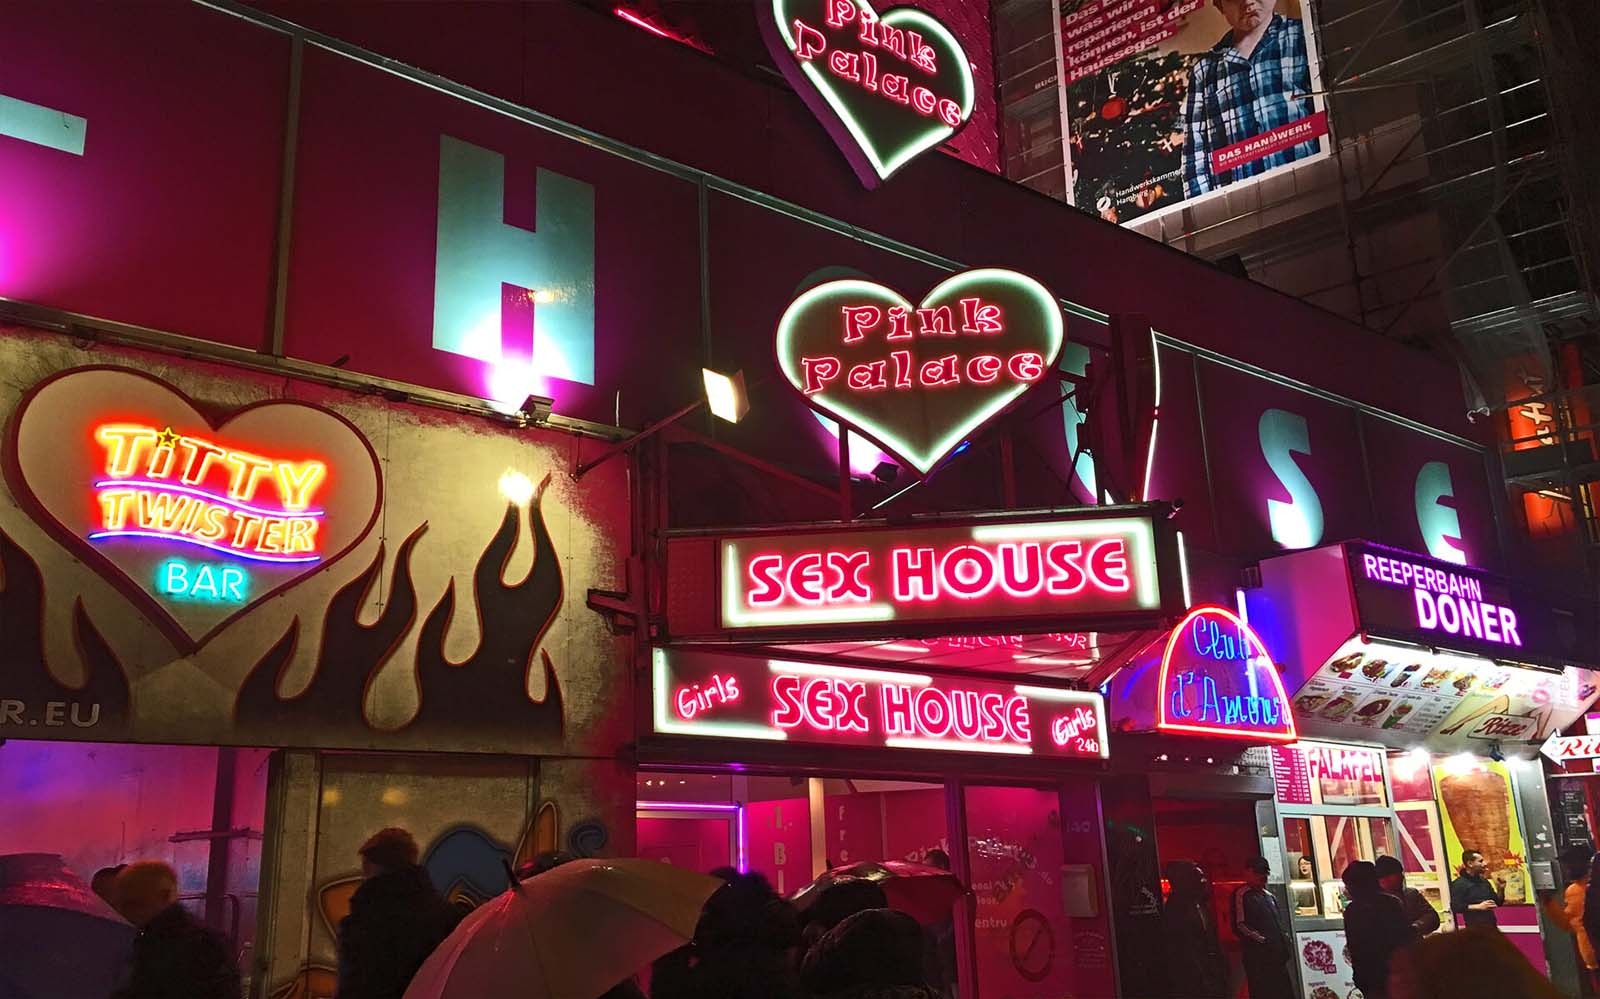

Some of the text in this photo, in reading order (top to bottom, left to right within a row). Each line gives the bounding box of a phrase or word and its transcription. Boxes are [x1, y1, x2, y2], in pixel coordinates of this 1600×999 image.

[827, 0, 937, 73] Pink
[1065, 4, 1099, 25] Das
[1066, 16, 1103, 39] was
[1067, 5, 1156, 53] reparieren
[1067, 0, 1198, 67] können, ist der
[794, 19, 963, 127] Palace
[1070, 29, 1173, 80] Haussegen.
[1218, 147, 1242, 162] DAS
[1116, 188, 1149, 206] Hamburg
[841, 297, 1002, 343] Pink
[801, 350, 1044, 395] Palace
[100, 490, 320, 555] TWISTER
[164, 561, 246, 601] BAR
[748, 539, 1131, 605] SEX HOUSE
[1363, 553, 1482, 601] REEPERBAHN
[1414, 588, 1523, 647] DONER
[0, 699, 100, 728] R.EU
[676, 674, 1097, 746] Girls SEX HOUSE Girls
[1309, 748, 1382, 783] FALAFEL
